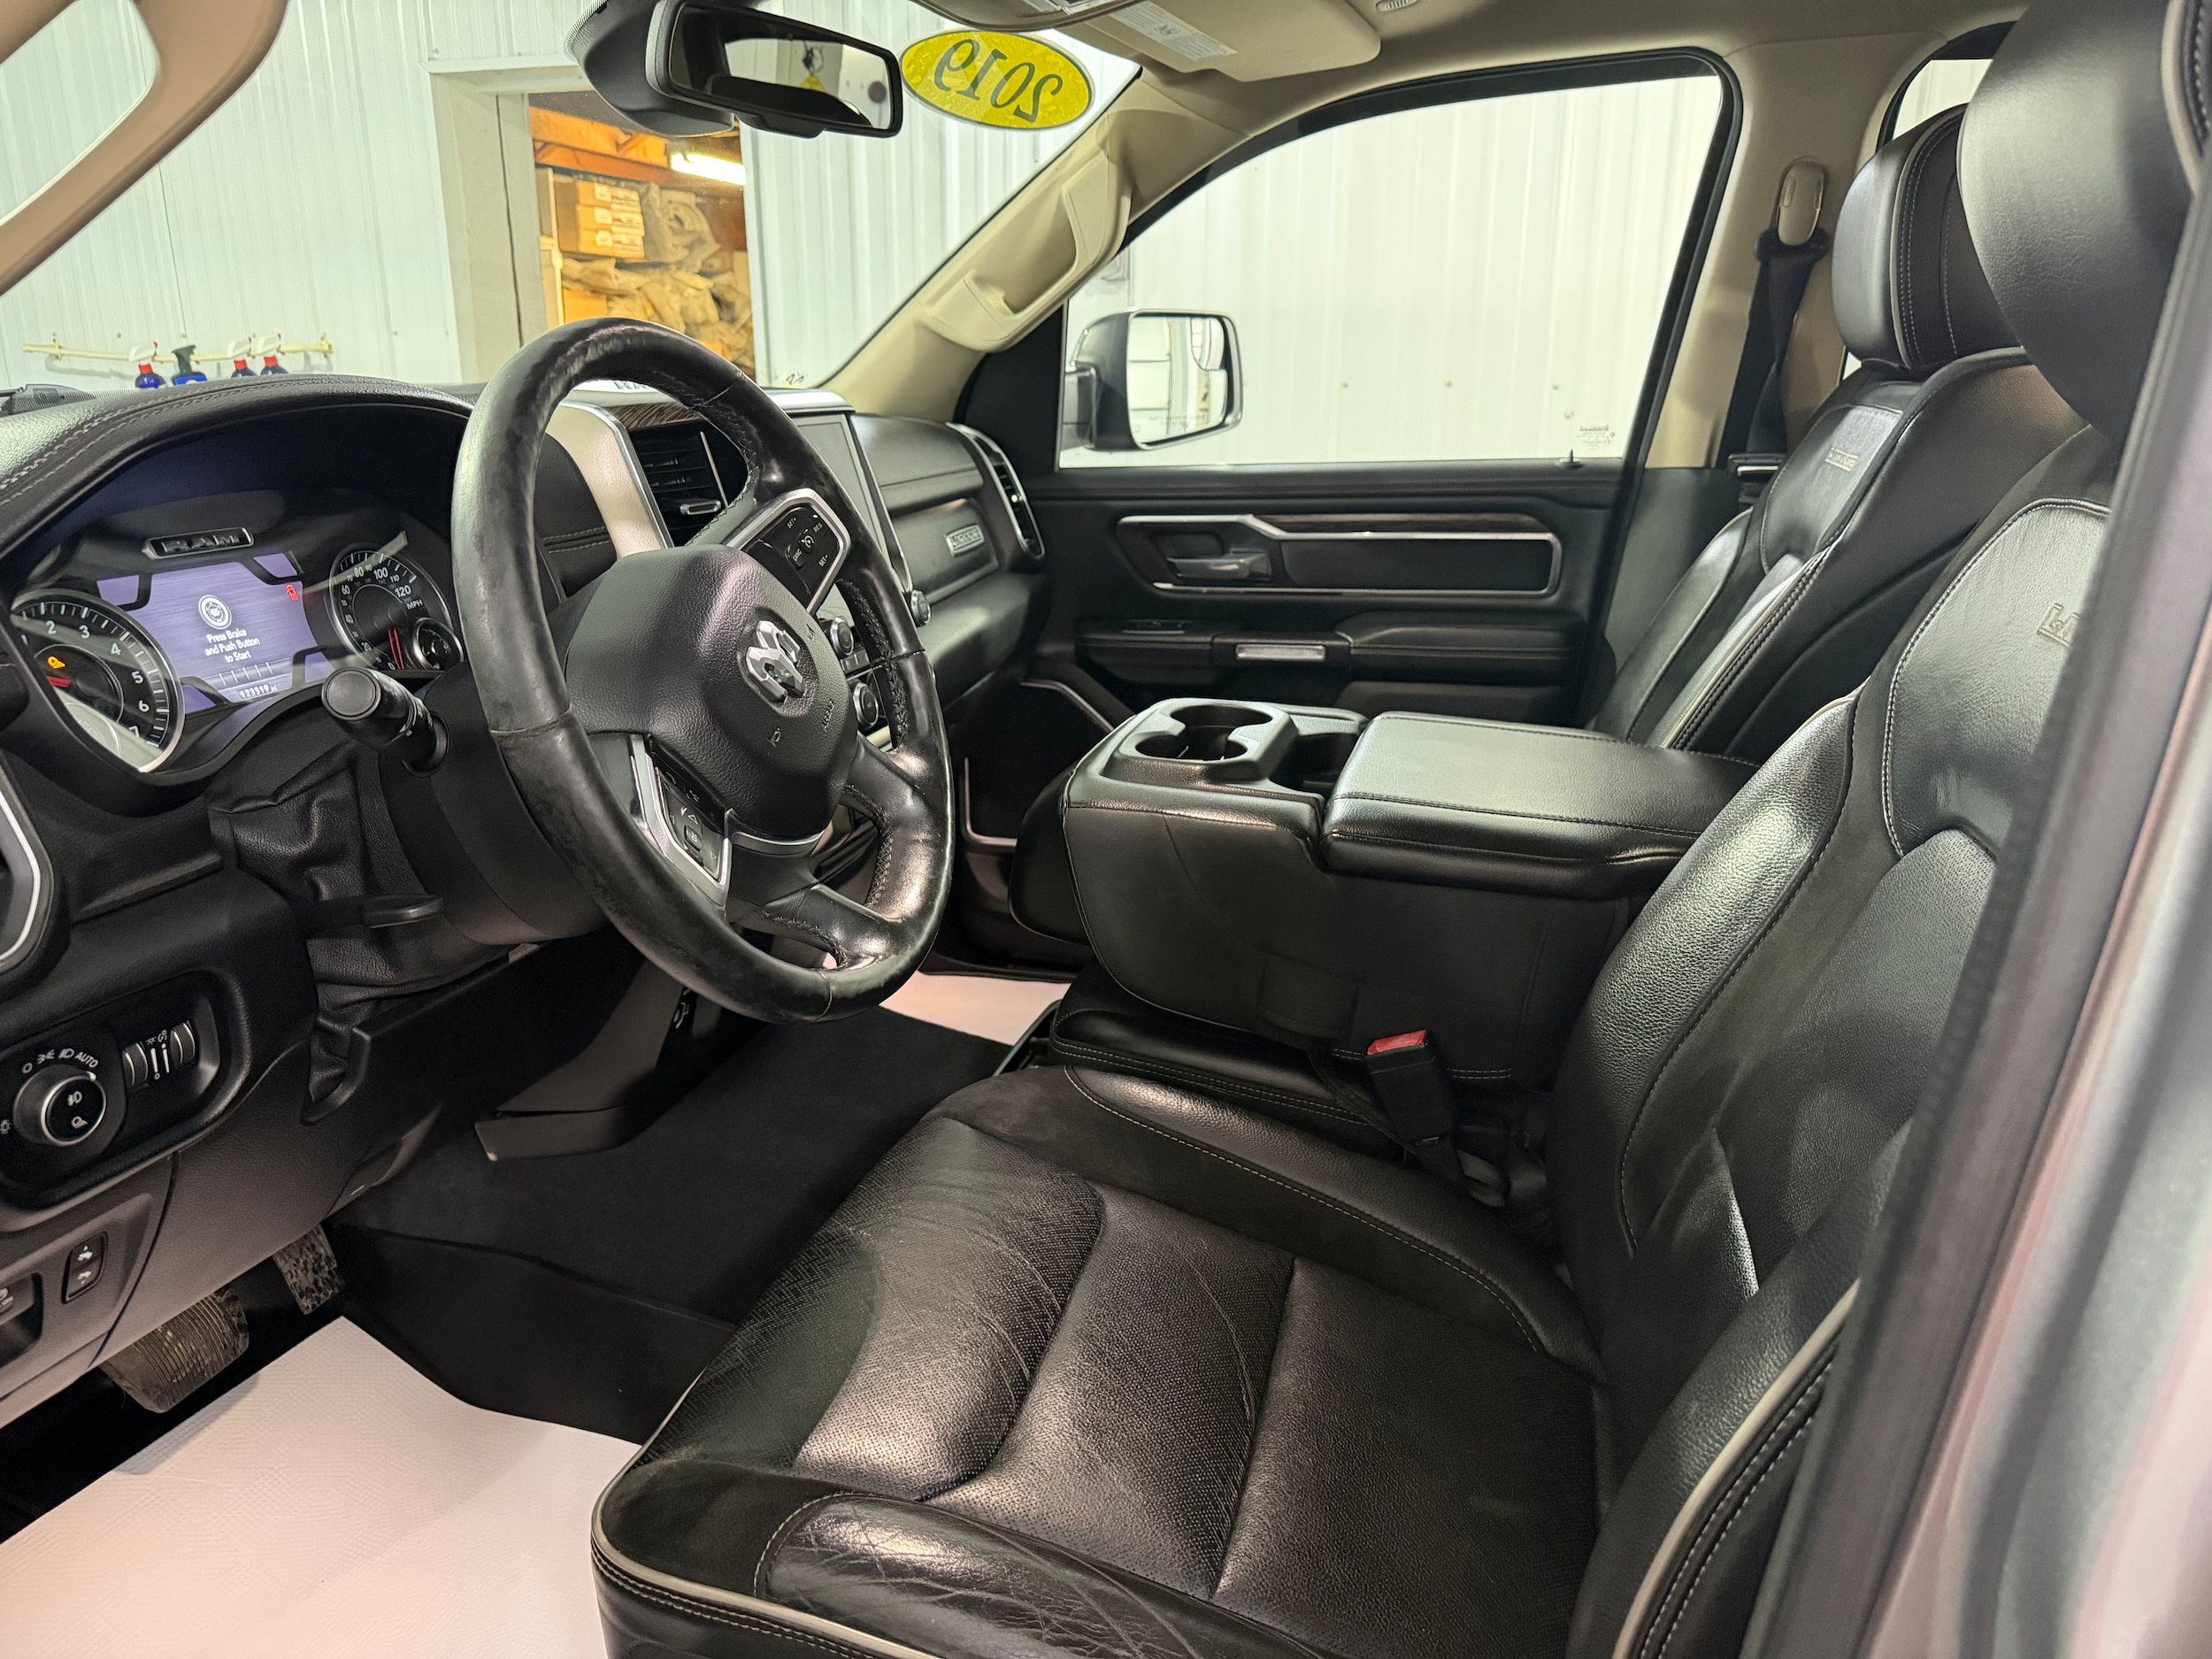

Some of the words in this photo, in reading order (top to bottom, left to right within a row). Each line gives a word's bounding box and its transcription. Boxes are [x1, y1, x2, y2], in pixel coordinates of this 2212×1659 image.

[161, 534, 240, 552] RAM
[354, 567, 364, 578] 80
[373, 567, 388, 580] 100
[390, 574, 400, 583] 110
[342, 585, 350, 595] 60
[395, 585, 411, 597] 120
[406, 599, 423, 610] MPH
[46, 621, 57, 634] 2
[79, 626, 90, 639] 3
[206, 634, 227, 643] Press
[226, 628, 247, 639] Brake
[111, 643, 120, 656] 4
[204, 644, 219, 656] and
[218, 641, 237, 652] Push
[236, 638, 260, 649] Button
[233, 650, 251, 661] Start
[132, 672, 143, 684] 5
[240, 685, 269, 698] 123319
[138, 700, 150, 712] 6
[129, 726, 140, 737] 7
[75, 1051, 98, 1068] AUTO
